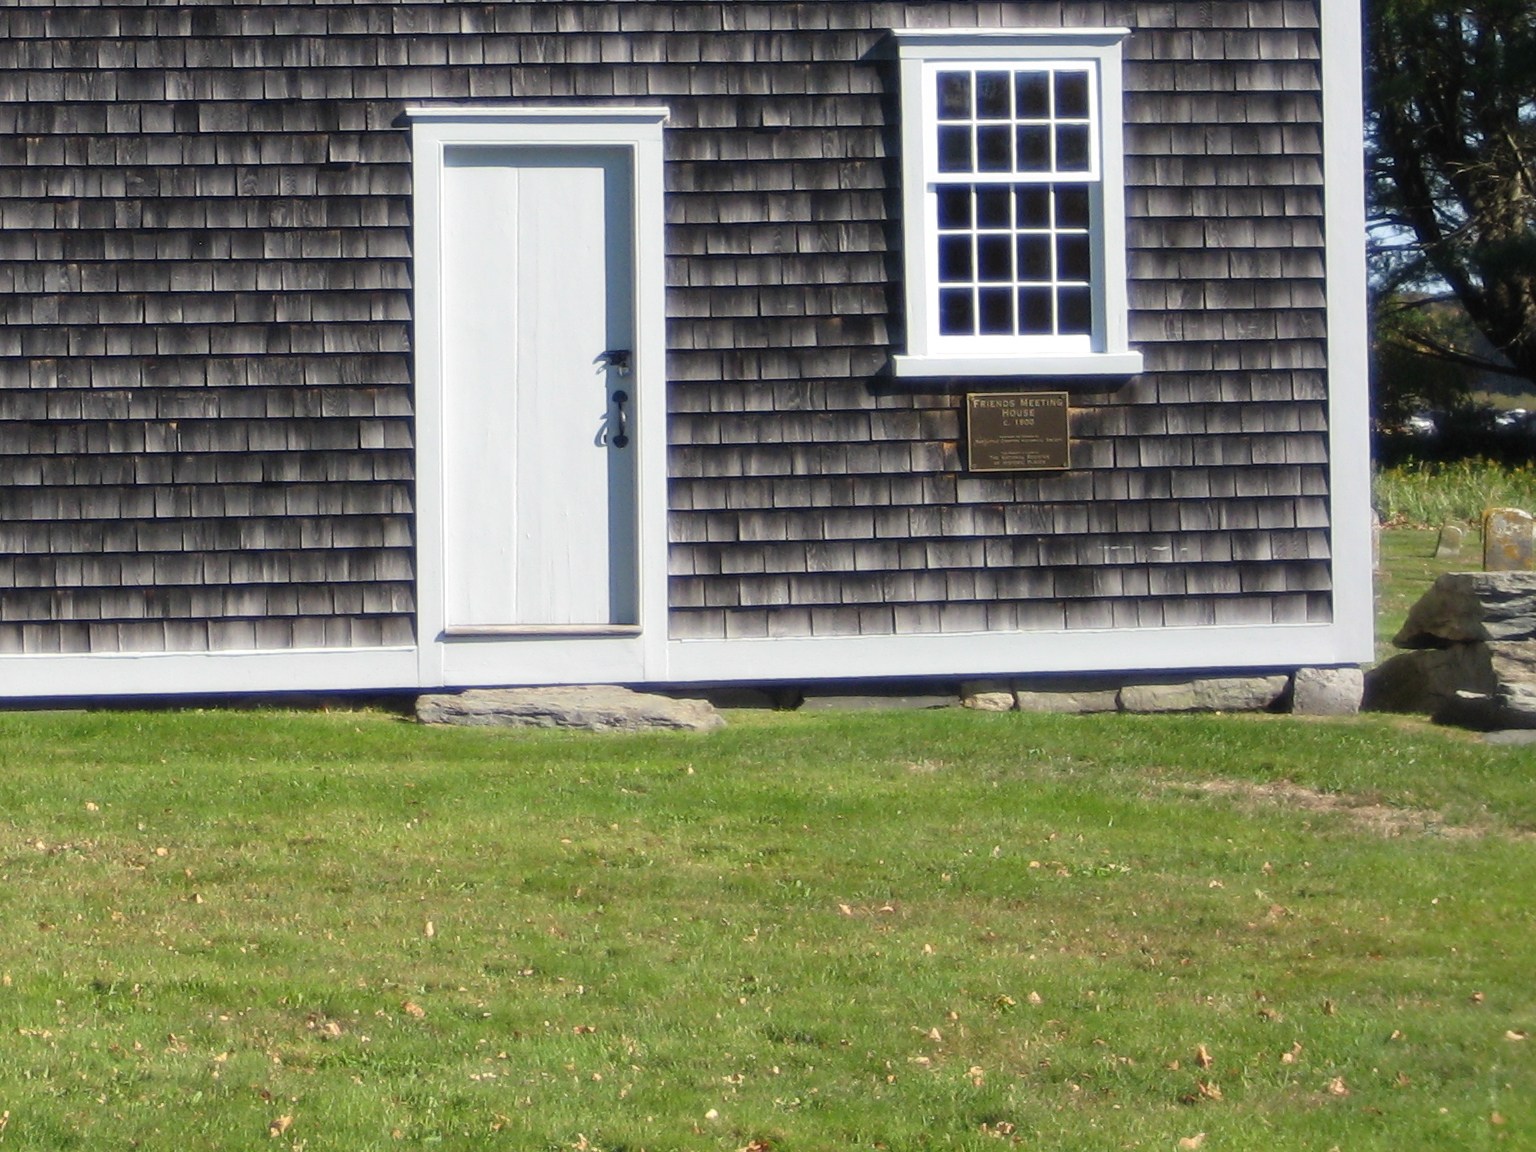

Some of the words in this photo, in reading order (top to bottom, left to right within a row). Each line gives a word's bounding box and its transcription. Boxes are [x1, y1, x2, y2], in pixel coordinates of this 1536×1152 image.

[973, 399, 1015, 408] FRIENDS
[1020, 398, 1063, 407] MEETING
[1002, 409, 1035, 417] HOUSE
